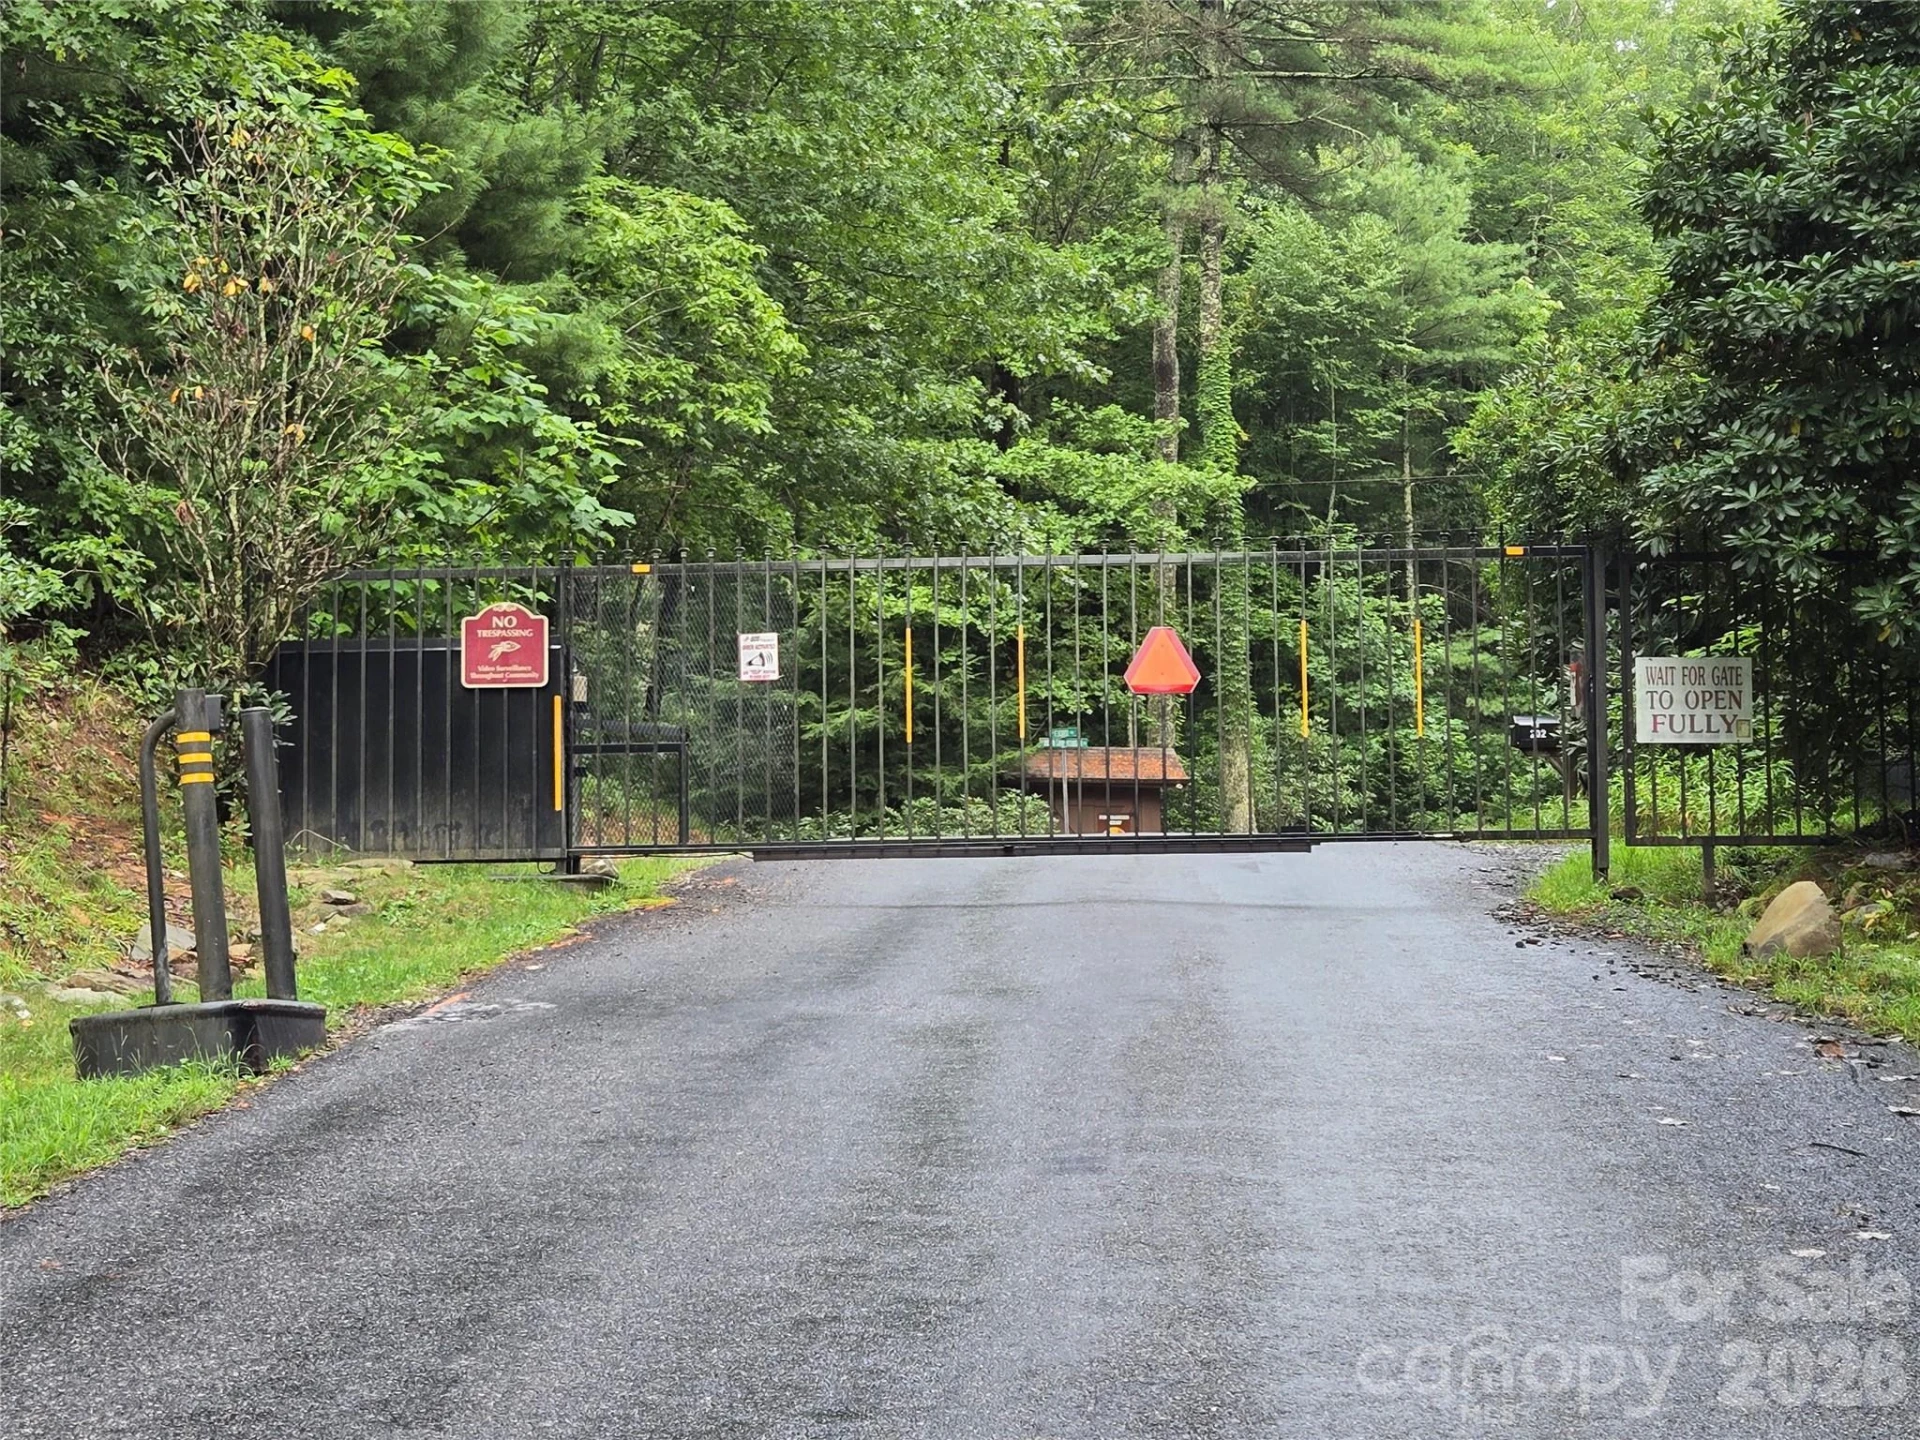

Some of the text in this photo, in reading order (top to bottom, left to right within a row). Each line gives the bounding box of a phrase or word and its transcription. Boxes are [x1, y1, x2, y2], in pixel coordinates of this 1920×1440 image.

[492, 616, 517, 628] NO
[476, 629, 534, 638] TRESPASSING
[470, 672, 504, 680] Throughout
[1645, 666, 1743, 686] WAIT FOR GATE
[1646, 690, 1744, 710] TO OPEN
[1651, 714, 1738, 734] FULLY
[1529, 728, 1547, 739] 202
